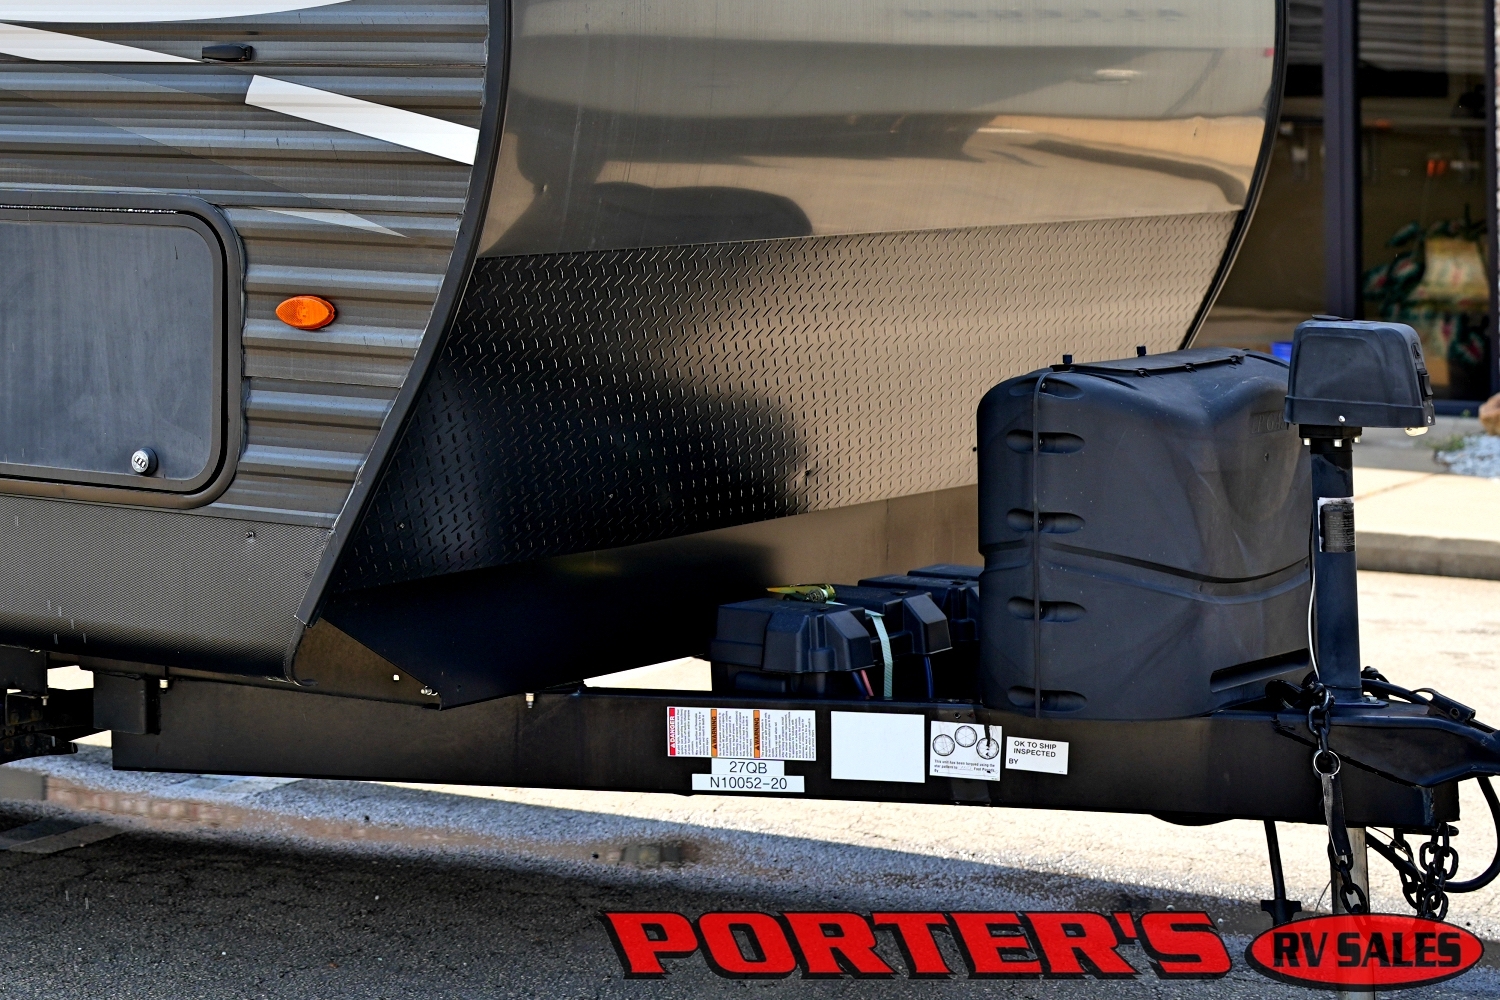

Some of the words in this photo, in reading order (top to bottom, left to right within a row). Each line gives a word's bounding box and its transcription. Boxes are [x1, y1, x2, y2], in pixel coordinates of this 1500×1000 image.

[1027, 741, 1038, 749] TO
[1039, 742, 1057, 750] SHIP
[1013, 748, 1056, 758] INSPECTED
[1008, 757, 1019, 765] BY
[729, 760, 768, 774] 27QB
[710, 776, 788, 791] N10052-20
